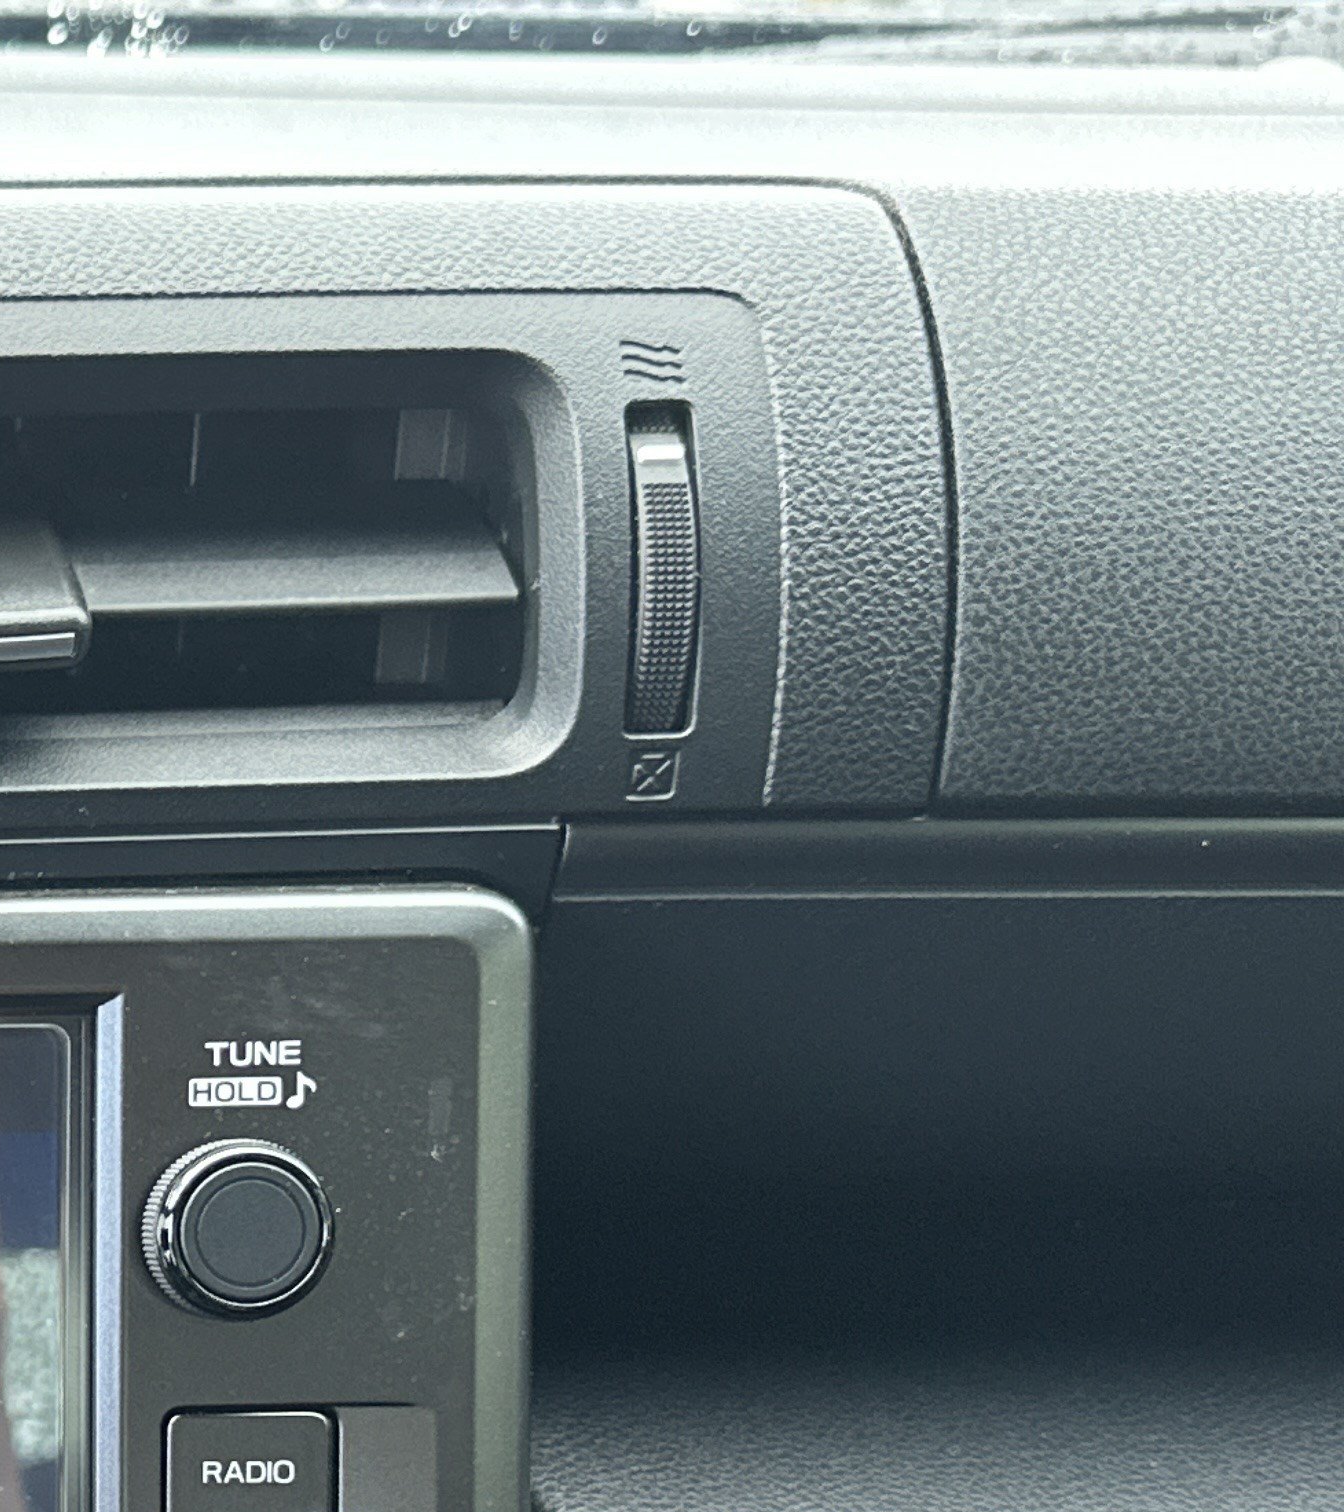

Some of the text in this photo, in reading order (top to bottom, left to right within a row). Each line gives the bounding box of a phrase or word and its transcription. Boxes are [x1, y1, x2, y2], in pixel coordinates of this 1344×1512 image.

[204, 1039, 302, 1067] TUNE
[192, 1081, 278, 1102] HOLD
[202, 1459, 296, 1484] RADIO
